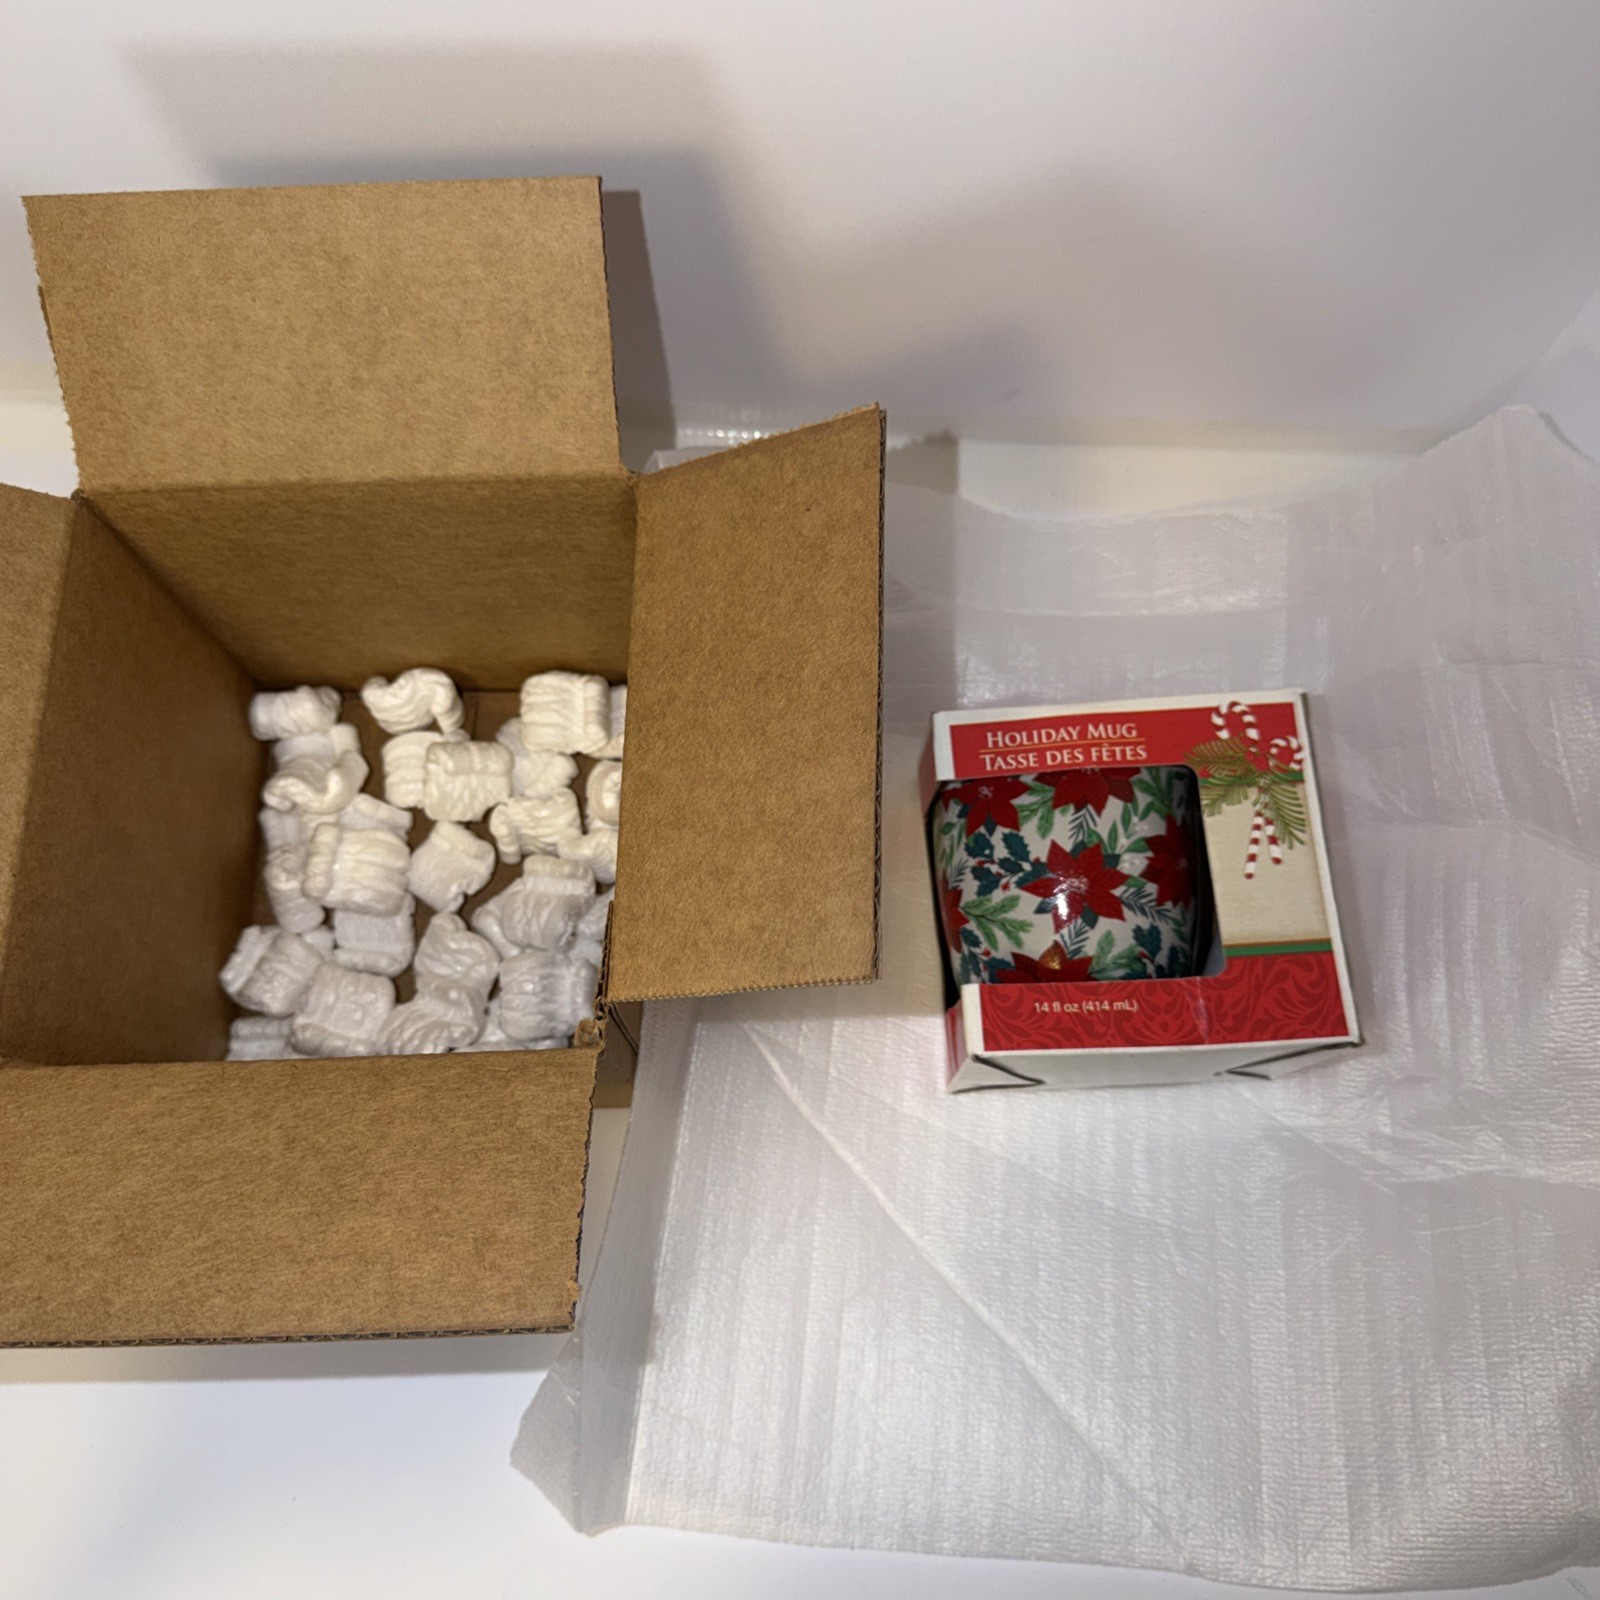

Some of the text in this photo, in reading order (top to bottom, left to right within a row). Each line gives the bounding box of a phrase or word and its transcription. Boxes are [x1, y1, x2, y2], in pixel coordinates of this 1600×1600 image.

[987, 723, 1138, 748] HOLIDAY MUG
[980, 743, 1147, 771] TASSE DES FÊTES
[1034, 999, 1139, 1014] 14 fl oz (414 mL)
